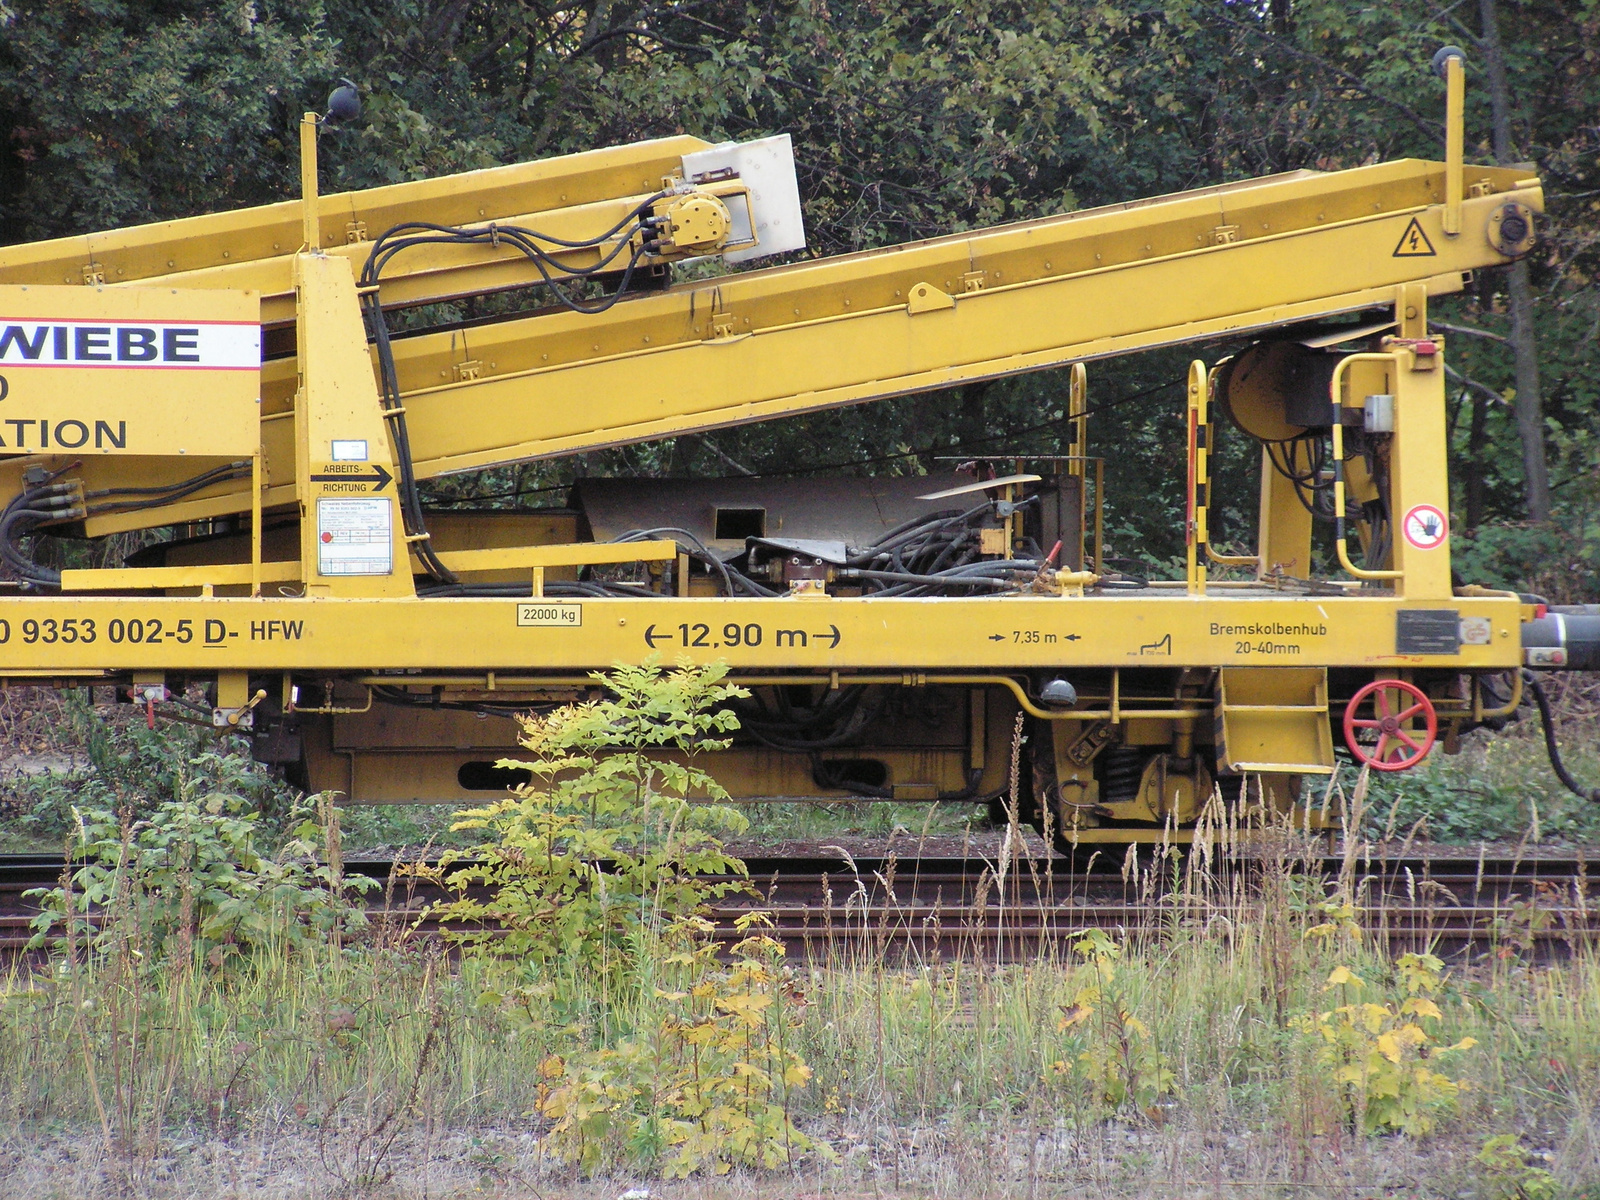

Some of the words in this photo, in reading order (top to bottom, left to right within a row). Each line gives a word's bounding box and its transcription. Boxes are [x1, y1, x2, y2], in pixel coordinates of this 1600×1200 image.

[0, 419, 127, 449] TION
[323, 464, 363, 474] ARBEITS-
[322, 483, 367, 492] RICHTUNG
[523, 608, 558, 620] 22000
[561, 608, 576, 622] kg
[22, 618, 97, 644] 9353
[108, 618, 194, 644] 002-5
[250, 620, 304, 640] HFW
[678, 623, 763, 649] 12,90
[775, 629, 808, 648] m
[1209, 622, 1328, 636] Bremskolbenhub
[1012, 630, 1041, 644] 7,35
[1044, 633, 1058, 644] m
[1234, 641, 1301, 655] 20-40mm
